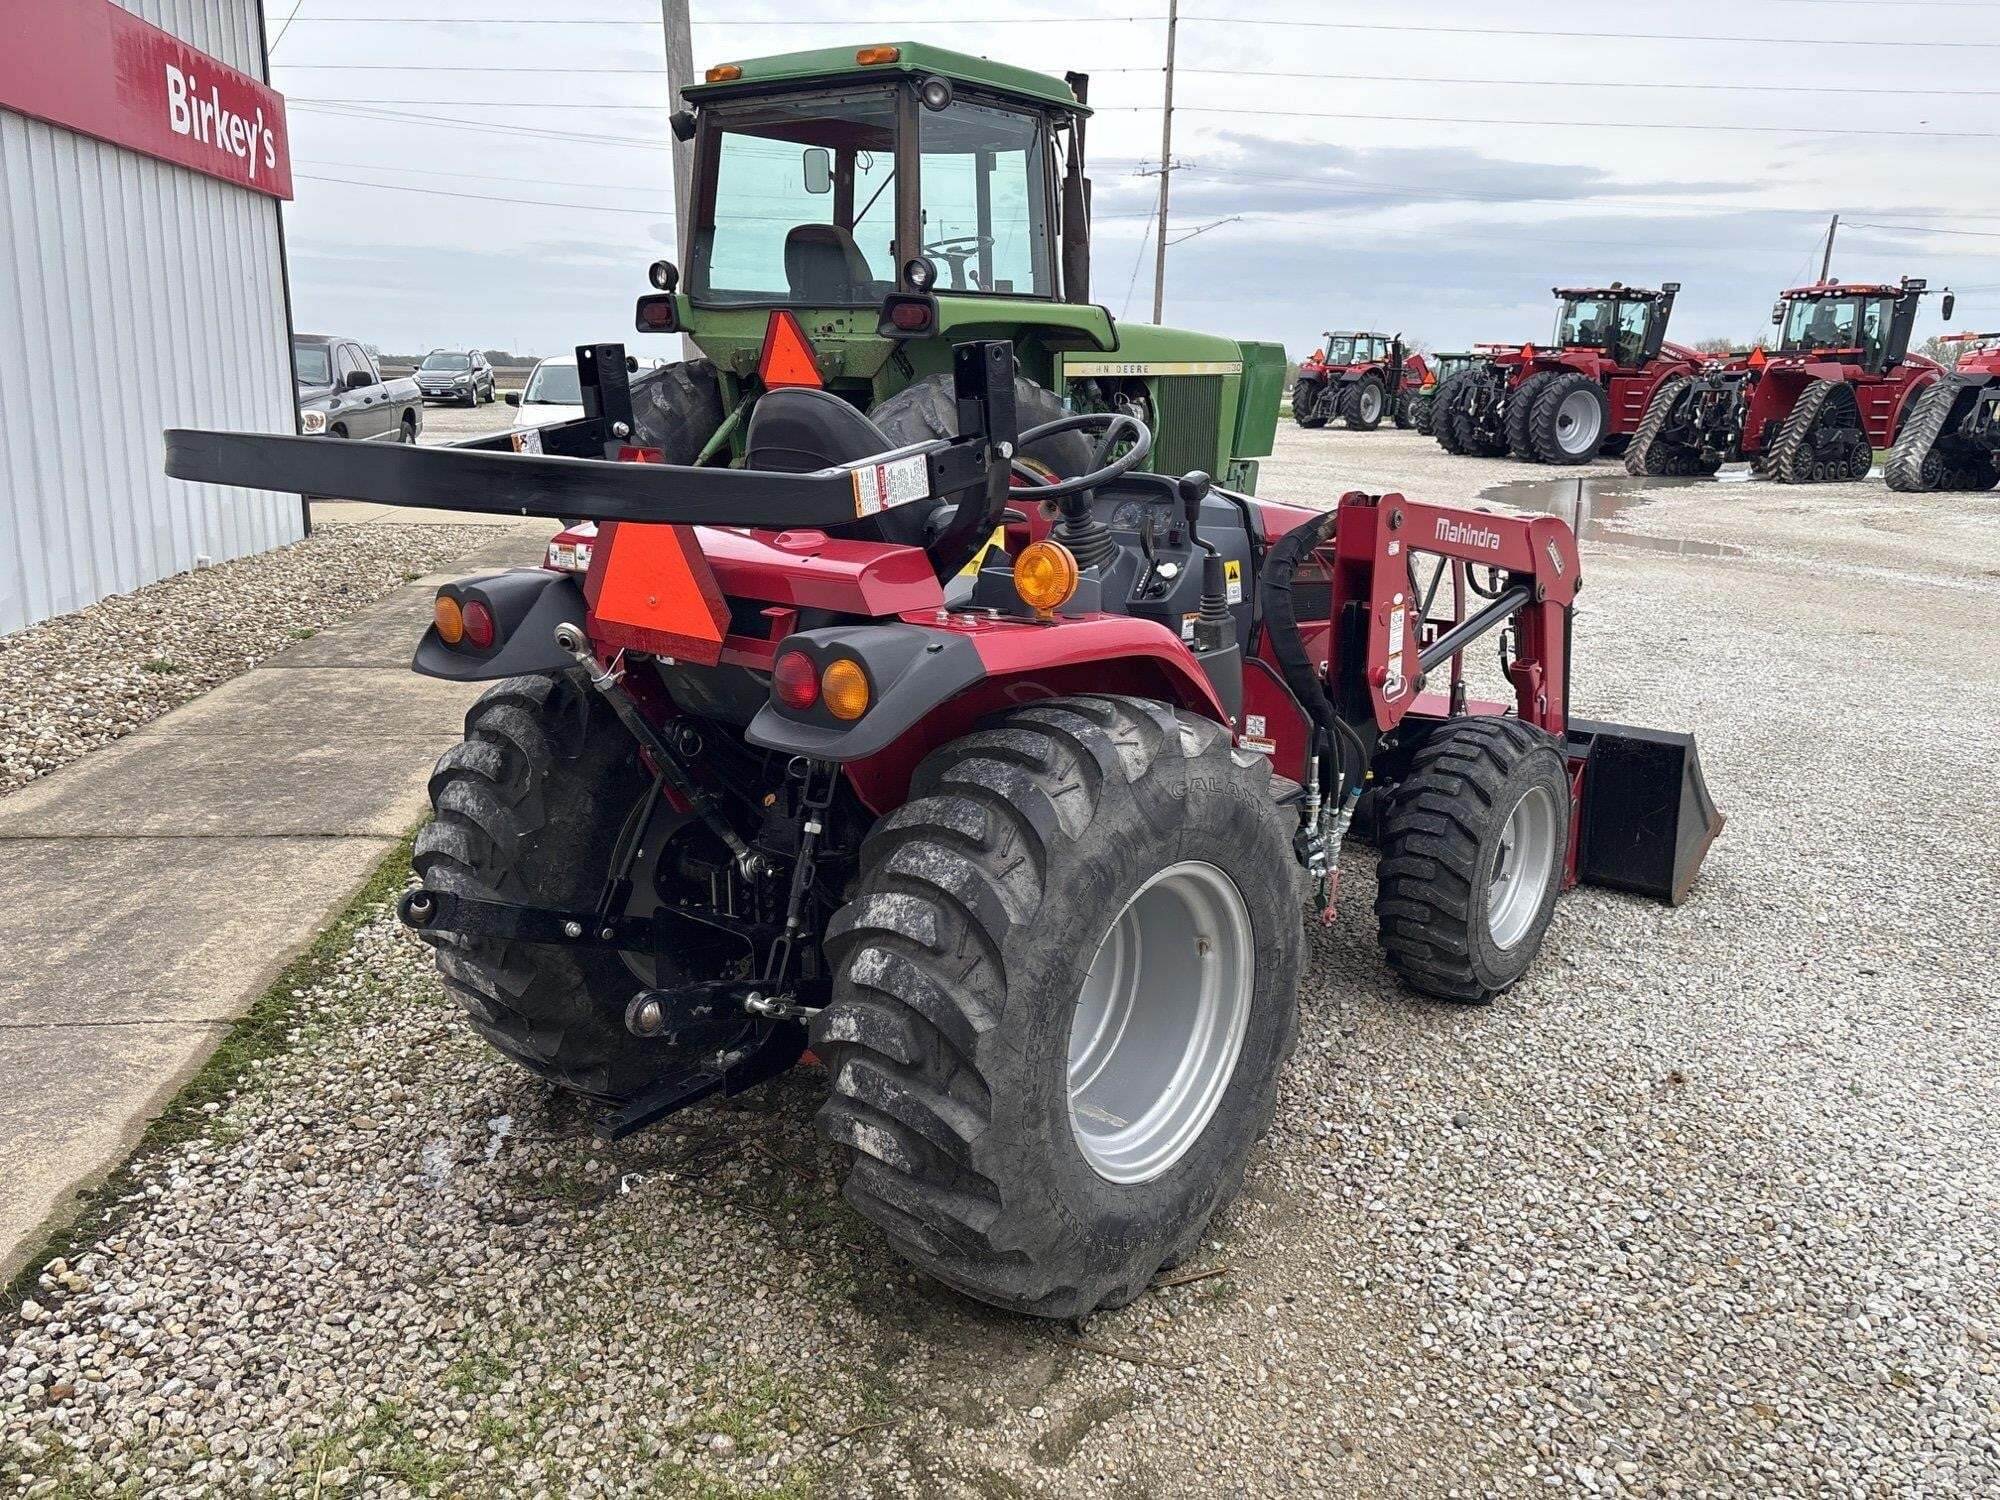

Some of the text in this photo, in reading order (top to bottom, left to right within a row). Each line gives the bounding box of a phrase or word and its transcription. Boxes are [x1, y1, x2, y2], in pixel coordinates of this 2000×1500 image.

[165, 63, 276, 179] Birkey's
[1116, 365, 1149, 374] DEERE
[1435, 517, 1500, 550] Mahindra
